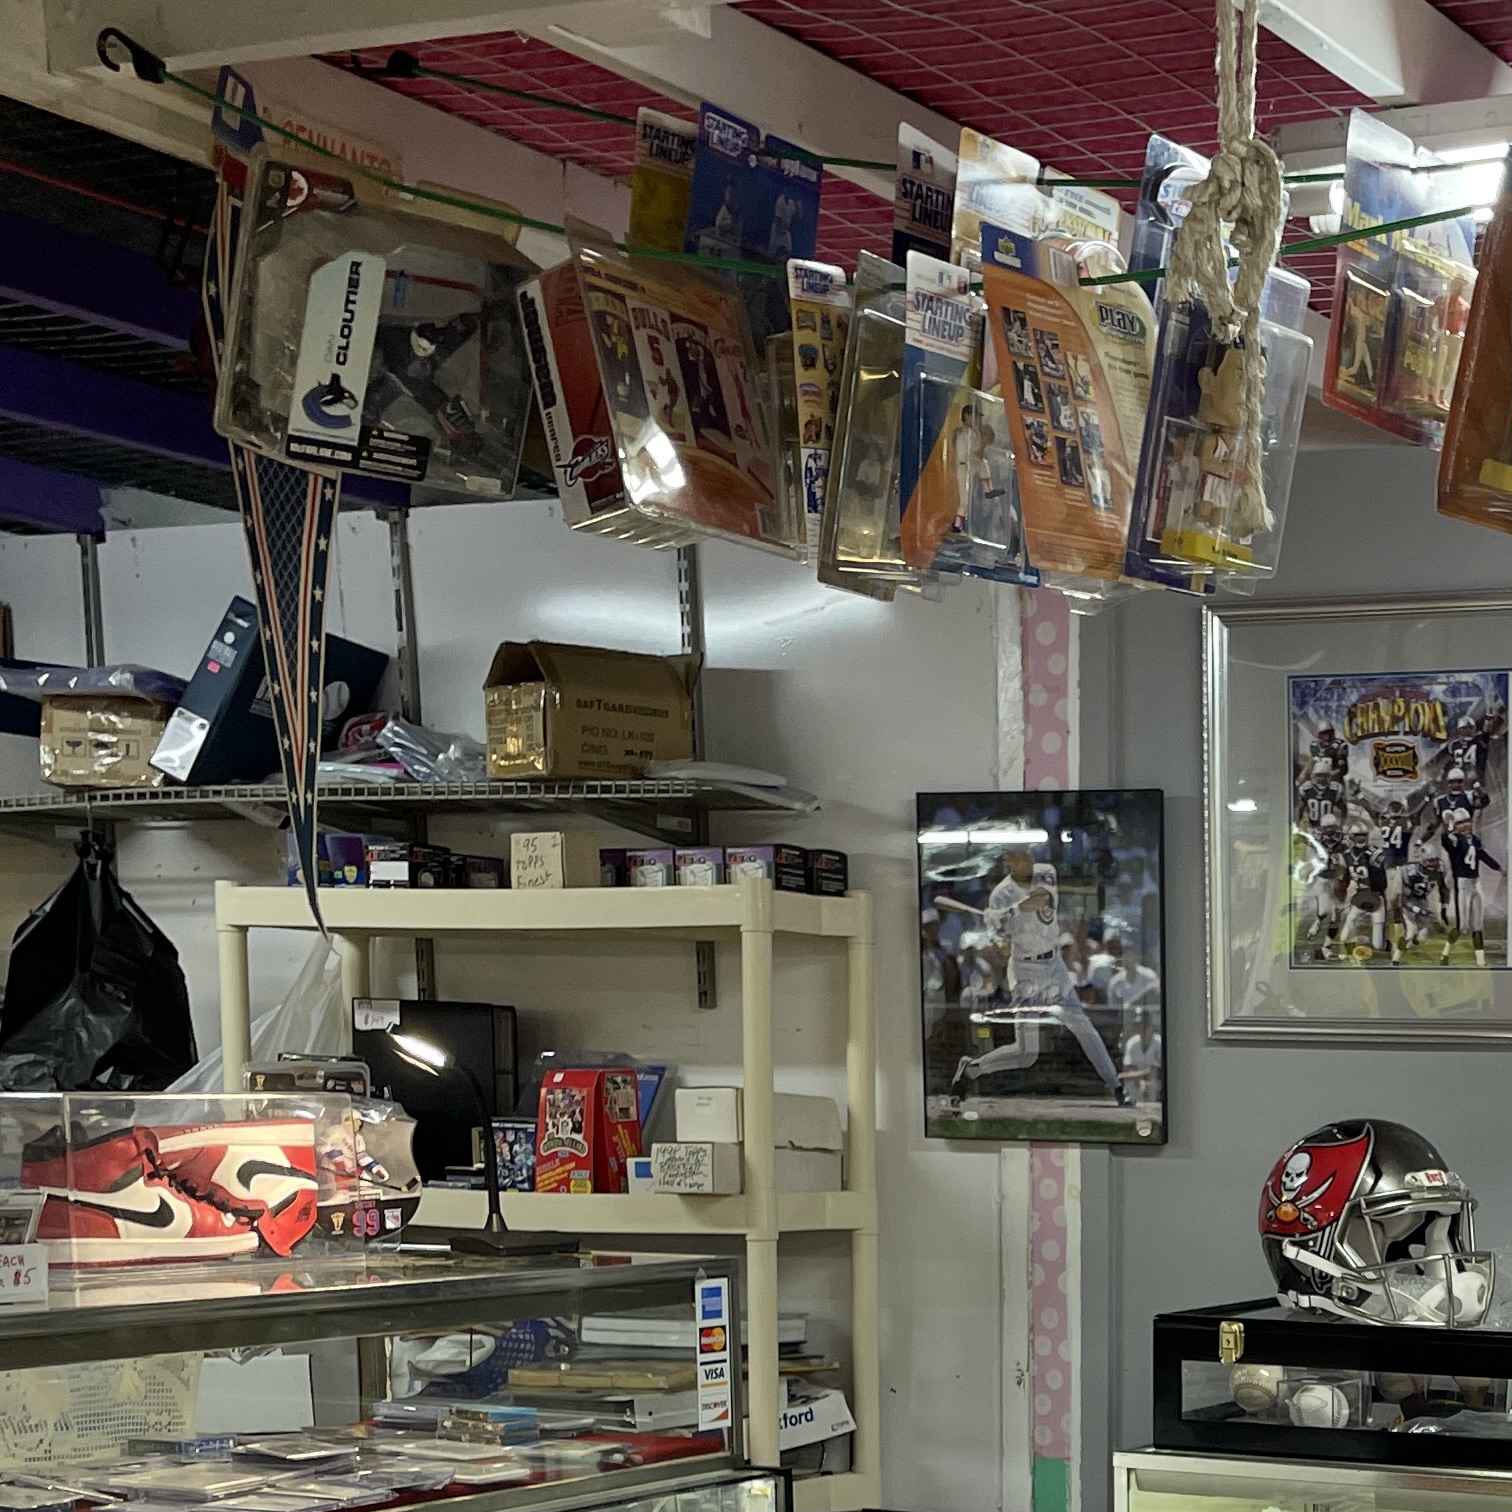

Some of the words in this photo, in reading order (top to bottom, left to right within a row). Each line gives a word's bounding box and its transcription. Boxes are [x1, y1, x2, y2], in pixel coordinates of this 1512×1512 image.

[336, 260, 363, 366] CLOUTIER
[914, 290, 973, 325] STARTING
[921, 312, 964, 344] LINEUP
[1453, 745, 1478, 768] 54
[1381, 826, 1404, 850] 24
[1464, 846, 1477, 870] 4
[352, 1209, 381, 1238] 99
[704, 1367, 725, 1381] VISA
[702, 1400, 727, 1411] DISCOVER
[779, 1407, 814, 1430] ford
